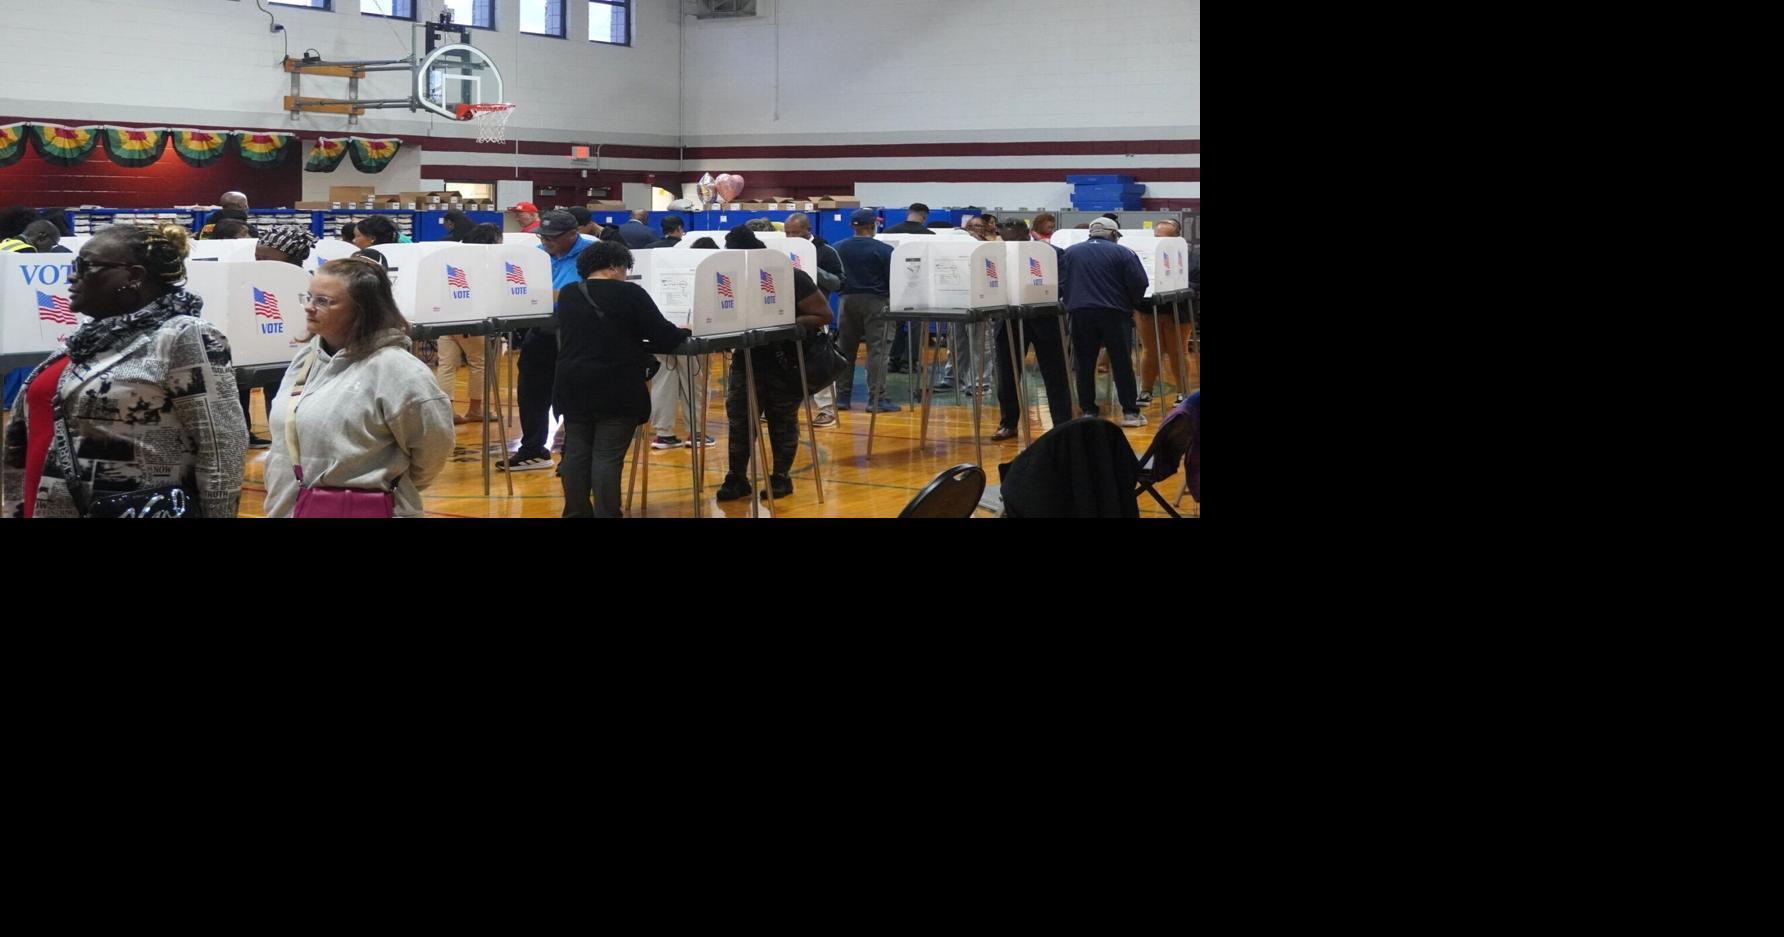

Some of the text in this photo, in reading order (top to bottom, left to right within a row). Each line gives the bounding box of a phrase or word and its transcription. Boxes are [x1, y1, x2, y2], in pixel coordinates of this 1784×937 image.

[20, 264, 72, 285] VOT
[453, 290, 470, 299] VOTE
[511, 287, 527, 295] VOTE
[764, 295, 776, 304] VOTE
[721, 300, 734, 309] VOTE
[261, 323, 284, 334] VOTE
